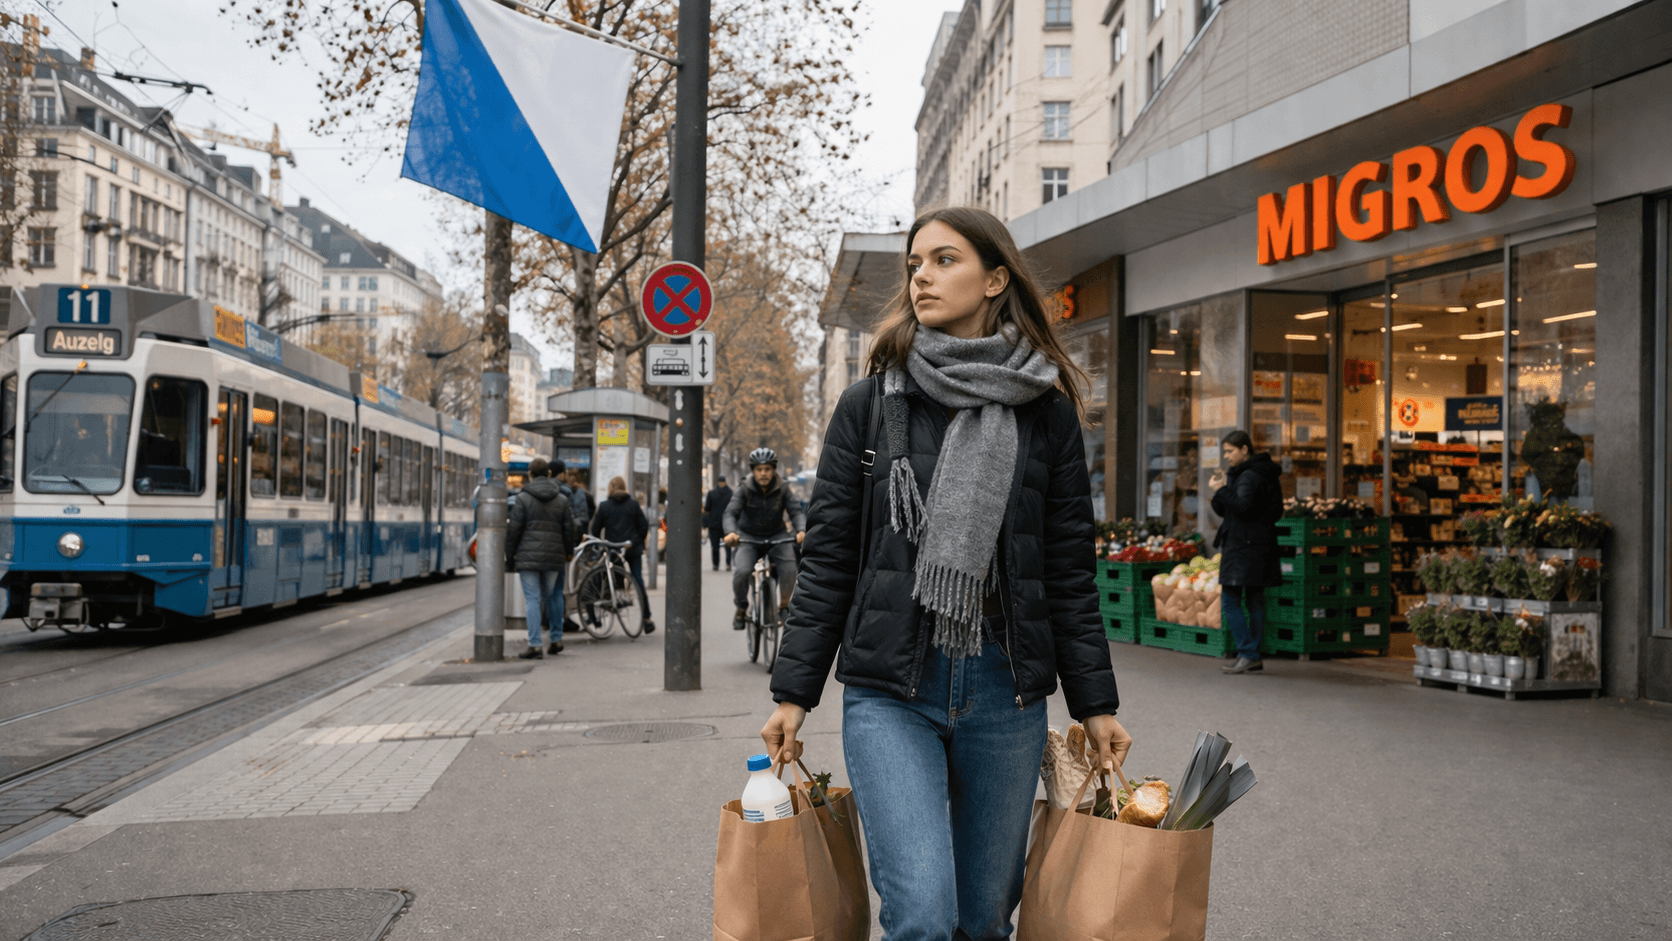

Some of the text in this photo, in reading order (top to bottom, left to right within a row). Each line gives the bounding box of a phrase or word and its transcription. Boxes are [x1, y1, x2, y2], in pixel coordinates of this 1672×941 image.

[1257, 103, 1576, 266] MIGROS
[67, 290, 99, 323] 11
[53, 331, 114, 355] Auzelg
